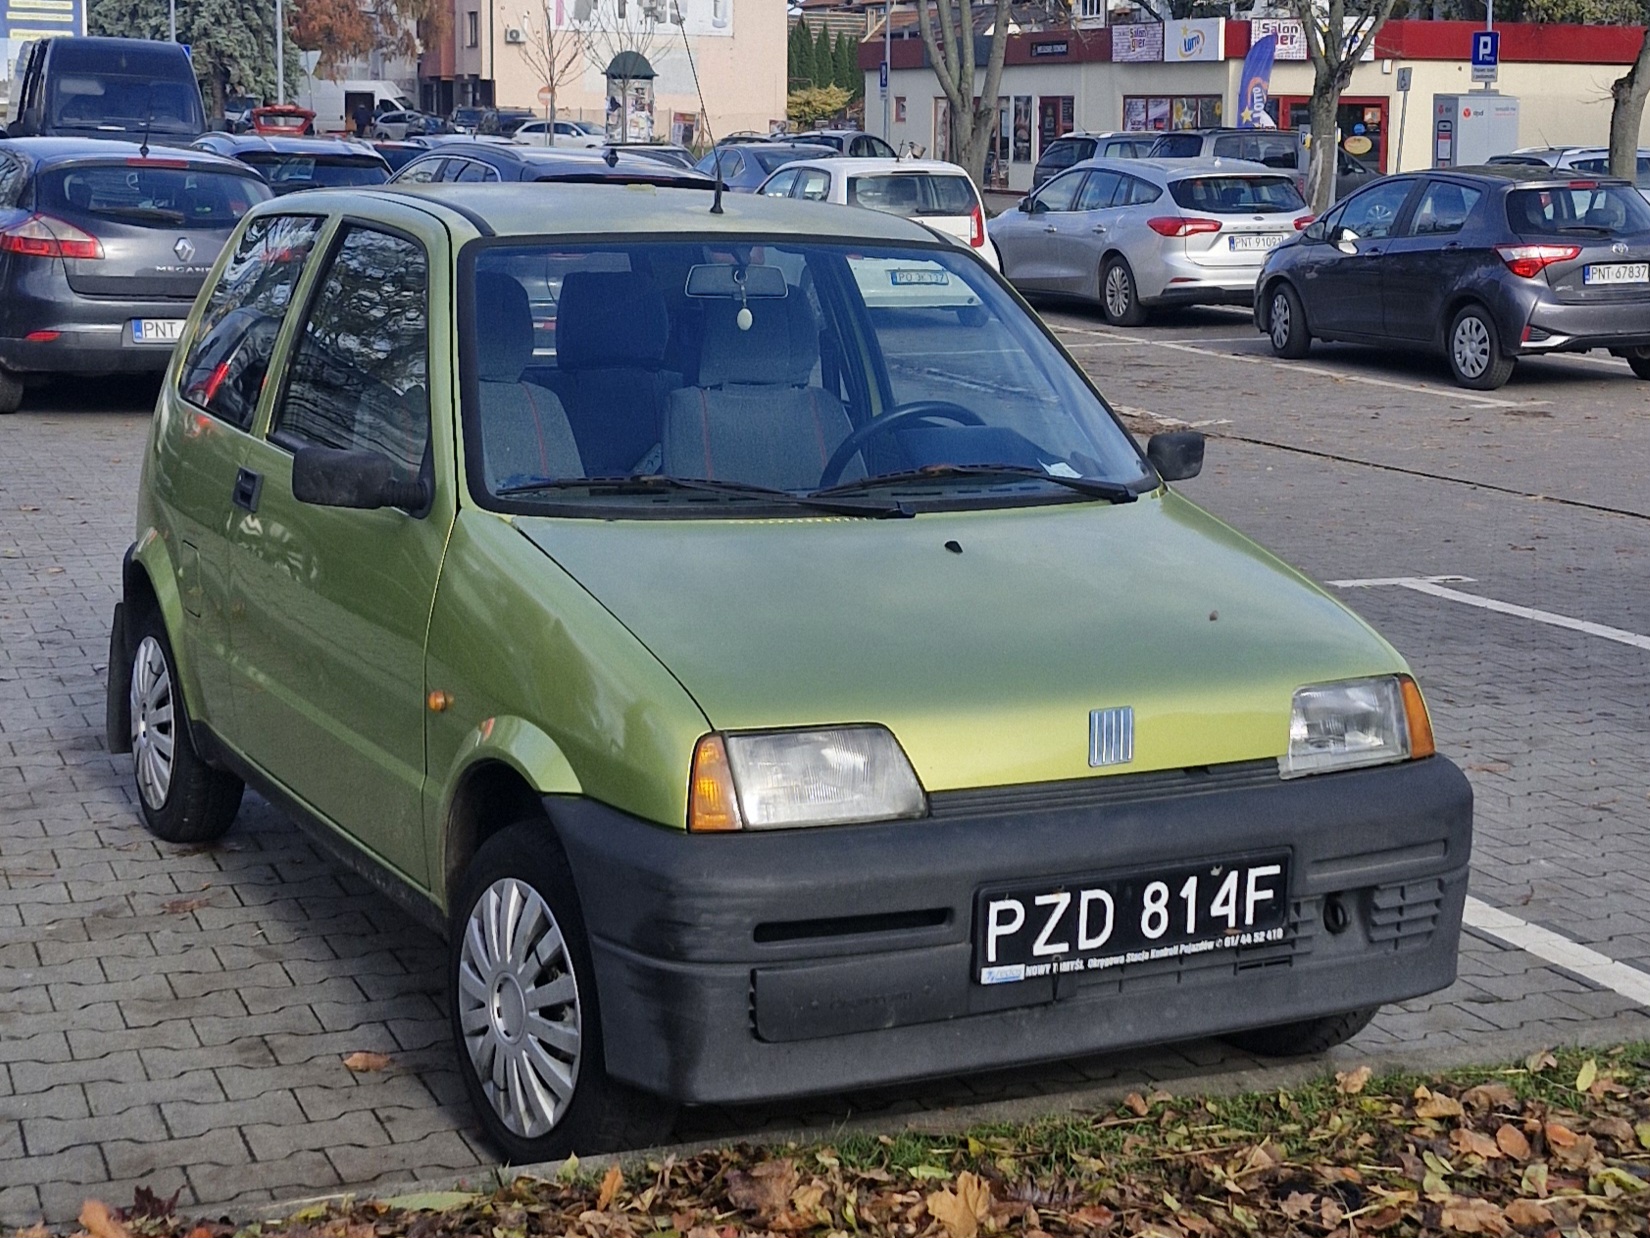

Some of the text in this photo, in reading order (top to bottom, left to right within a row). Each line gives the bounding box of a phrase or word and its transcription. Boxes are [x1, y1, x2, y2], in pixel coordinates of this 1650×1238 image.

[1129, 27, 1147, 39] Salon
[1262, 22, 1298, 34] Salon
[1183, 34, 1201, 53] LOTTO
[1478, 36, 1492, 61] P
[1252, 86, 1264, 118] LOTTO
[1235, 237, 1252, 248] PNT
[898, 272, 913, 282] PO
[1591, 265, 1648, 281] PNT 67837
[143, 321, 176, 338] PNT
[986, 864, 1281, 963] PZD 814F
[1025, 963, 1051, 977] NOWY
[1126, 949, 1149, 963] Stacja
[1179, 940, 1215, 955] Pojazdów
